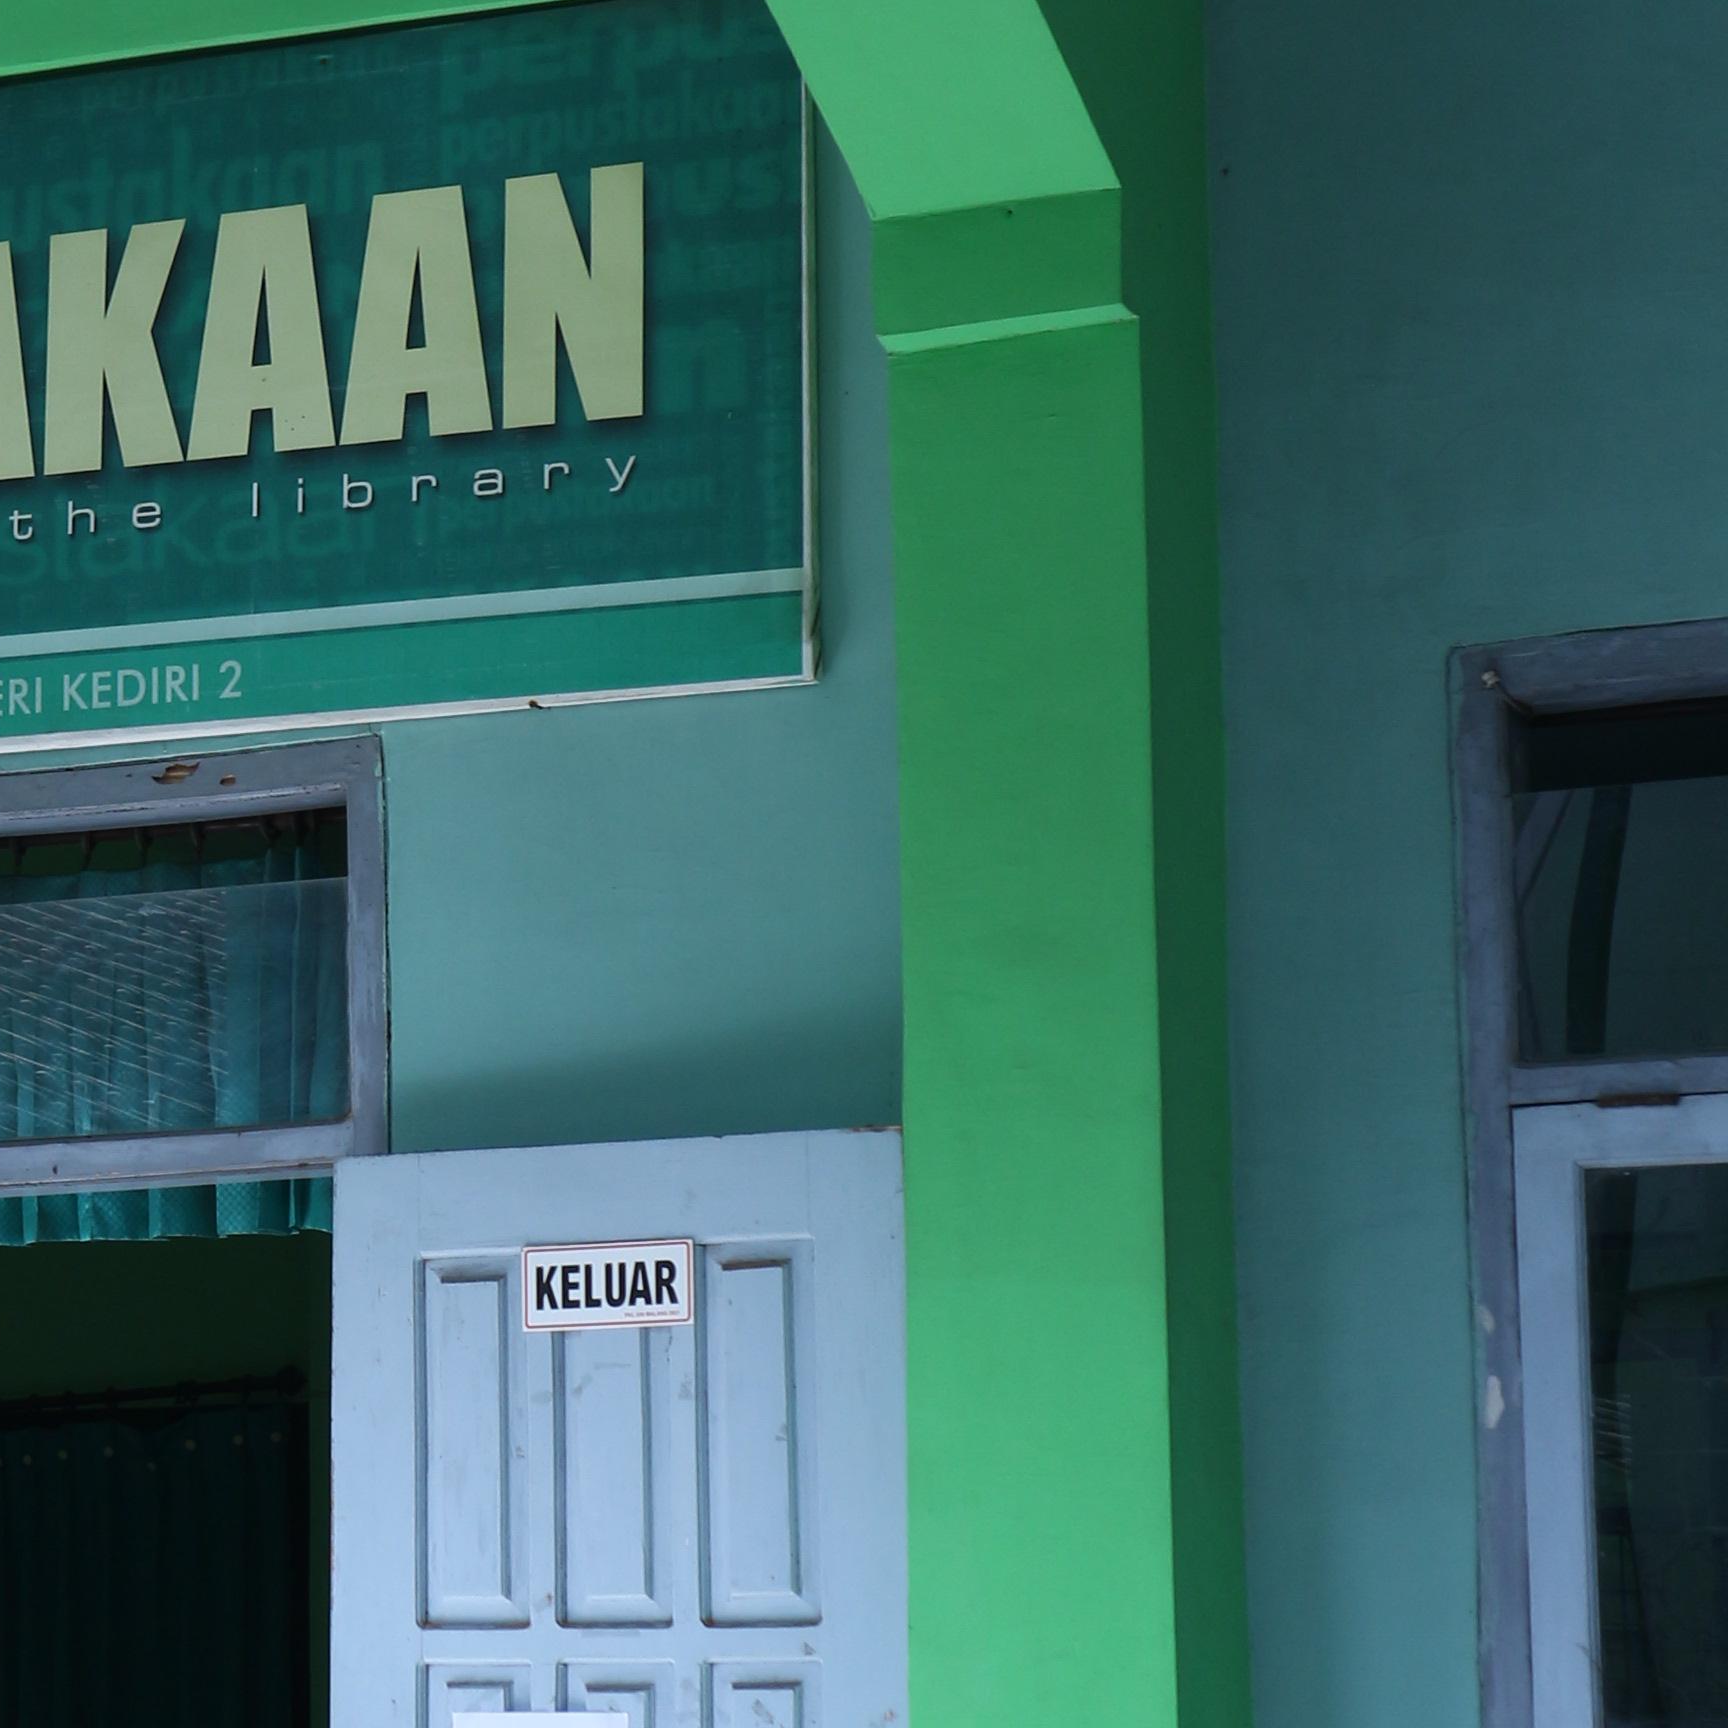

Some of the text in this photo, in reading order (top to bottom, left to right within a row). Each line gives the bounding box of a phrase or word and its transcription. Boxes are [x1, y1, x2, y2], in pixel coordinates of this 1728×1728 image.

[9, 456, 637, 541] the library
[63, 664, 201, 712] KEDIRI
[218, 660, 244, 699] 2
[535, 1259, 679, 1310] KELUAR
